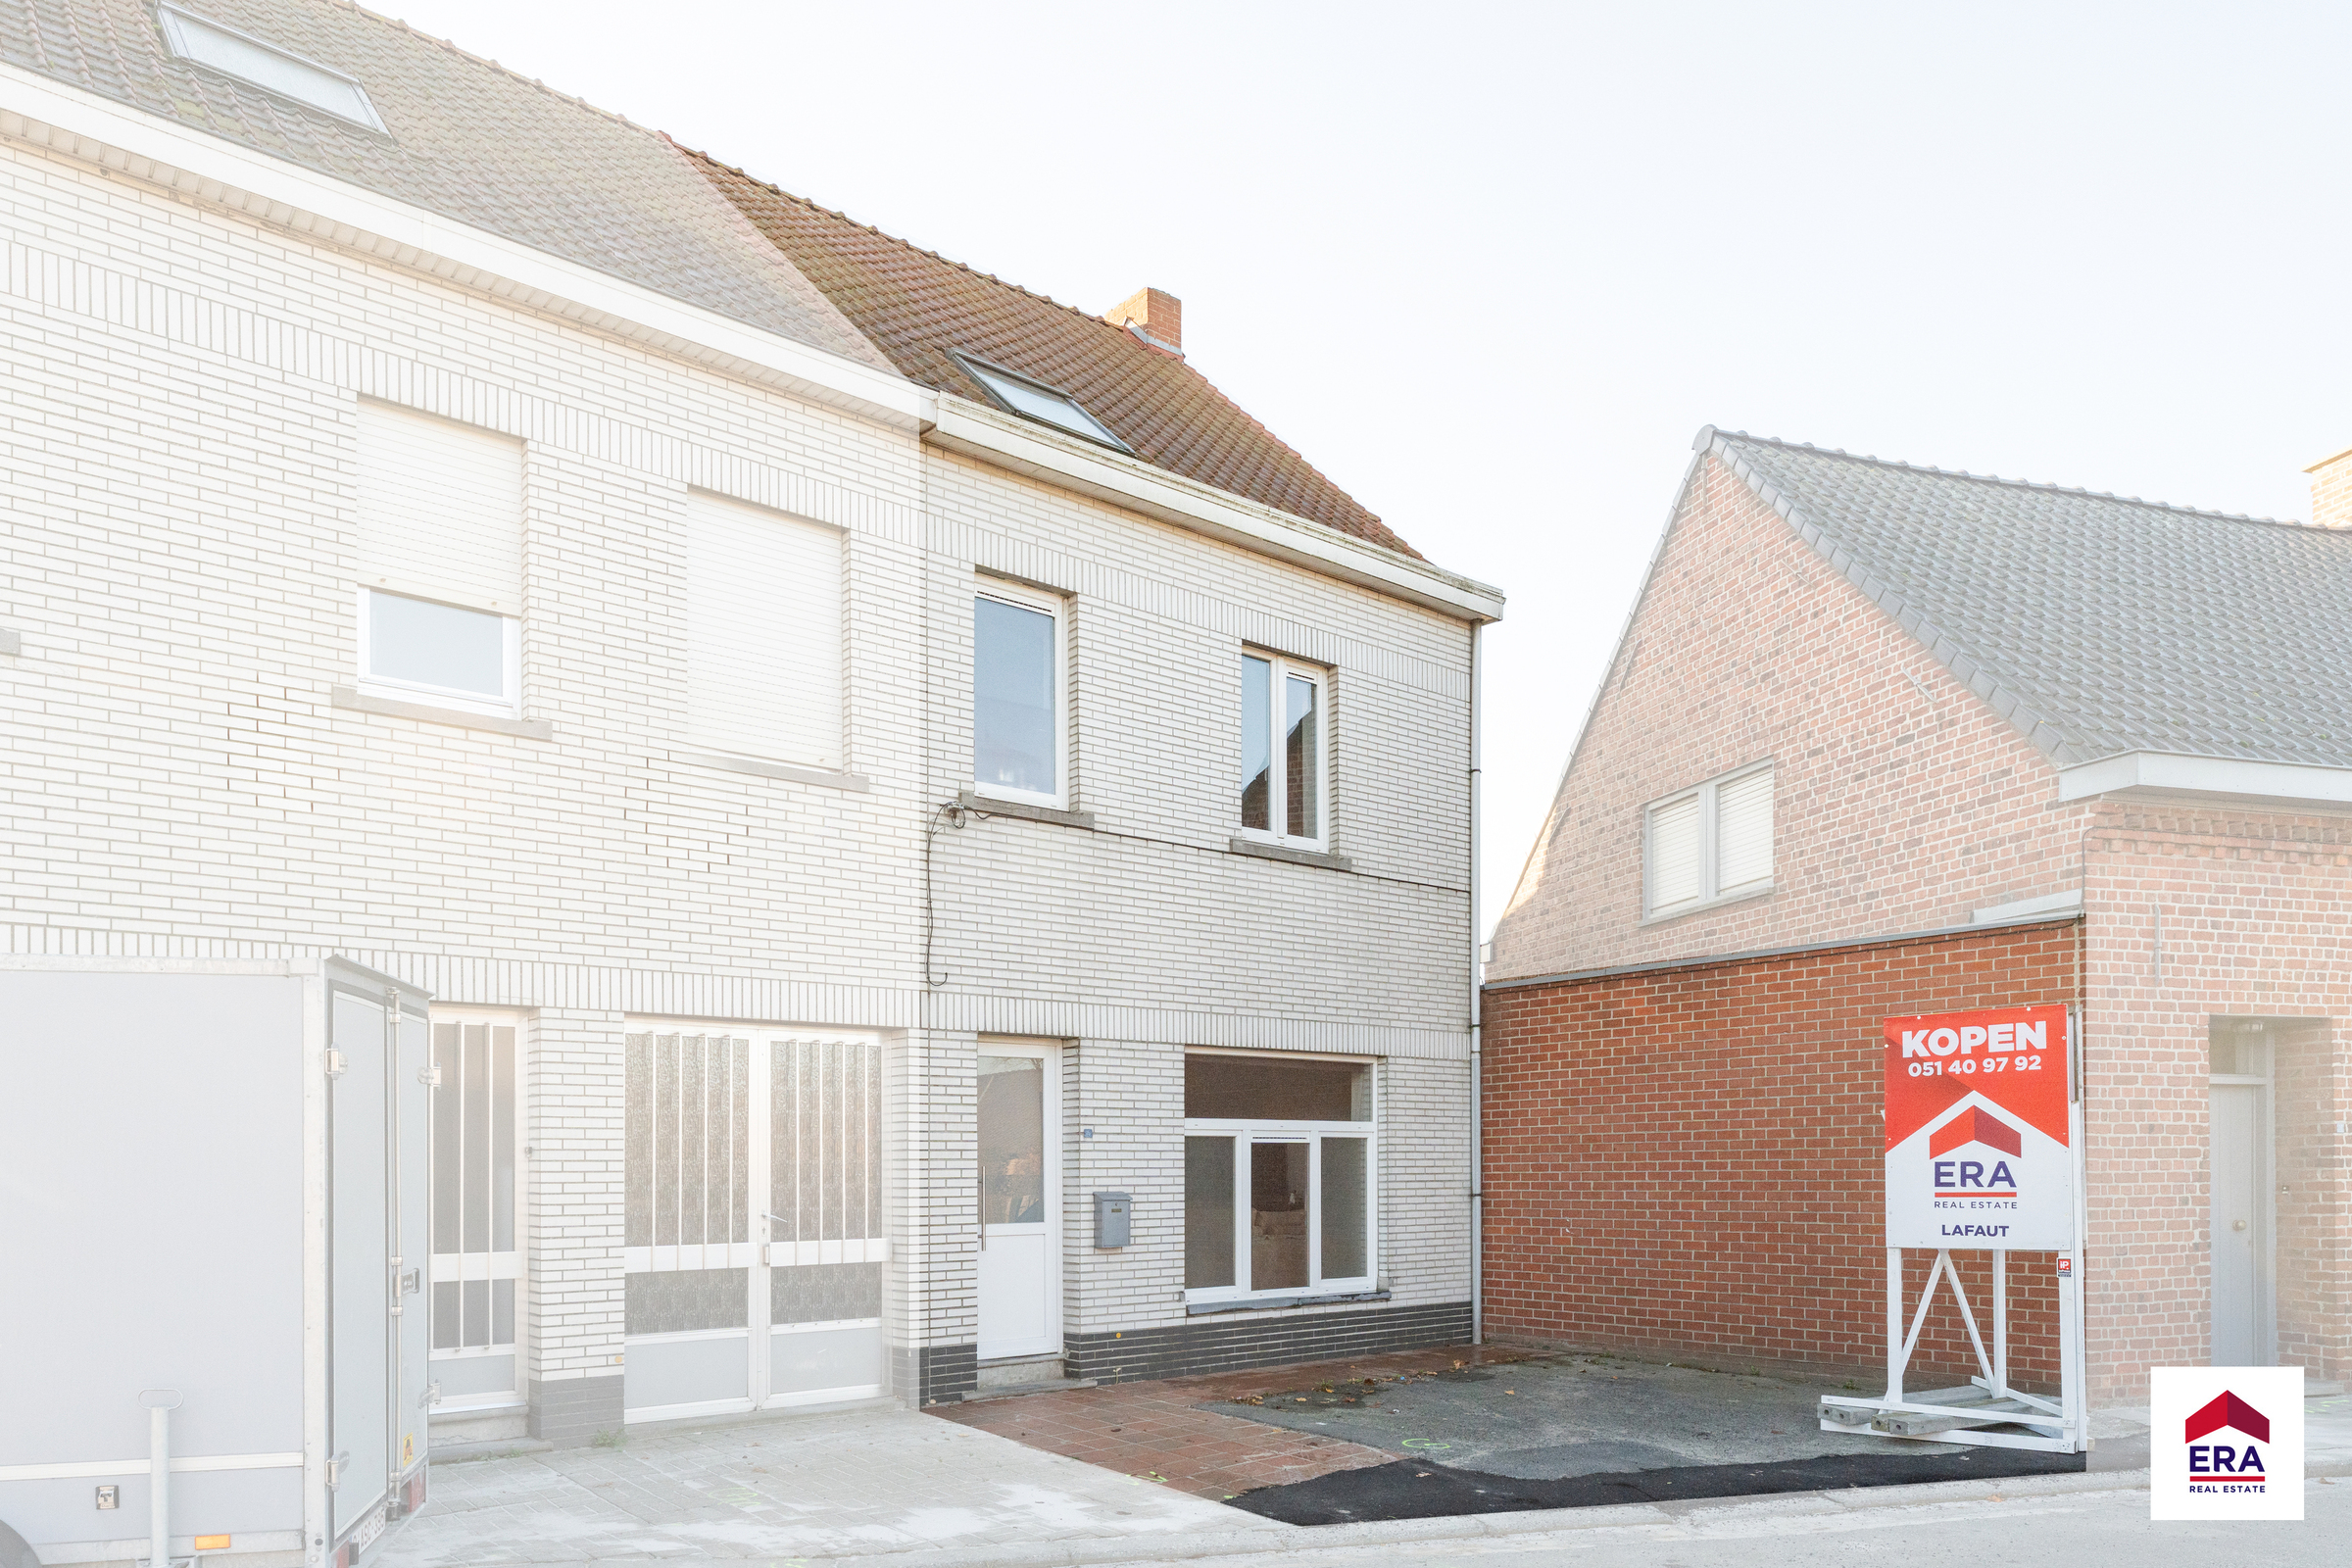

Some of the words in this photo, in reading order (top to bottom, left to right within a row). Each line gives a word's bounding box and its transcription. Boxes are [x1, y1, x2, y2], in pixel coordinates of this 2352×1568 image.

[1902, 1020, 2047, 1058] KOPEN
[1908, 1061, 1942, 1077] 051
[1947, 1059, 1977, 1075] 40
[1983, 1057, 2009, 1073] 97
[2014, 1055, 2041, 1071] 92
[1935, 1161, 2017, 1188] ERA
[1941, 1224, 2010, 1237] LAFAUT
